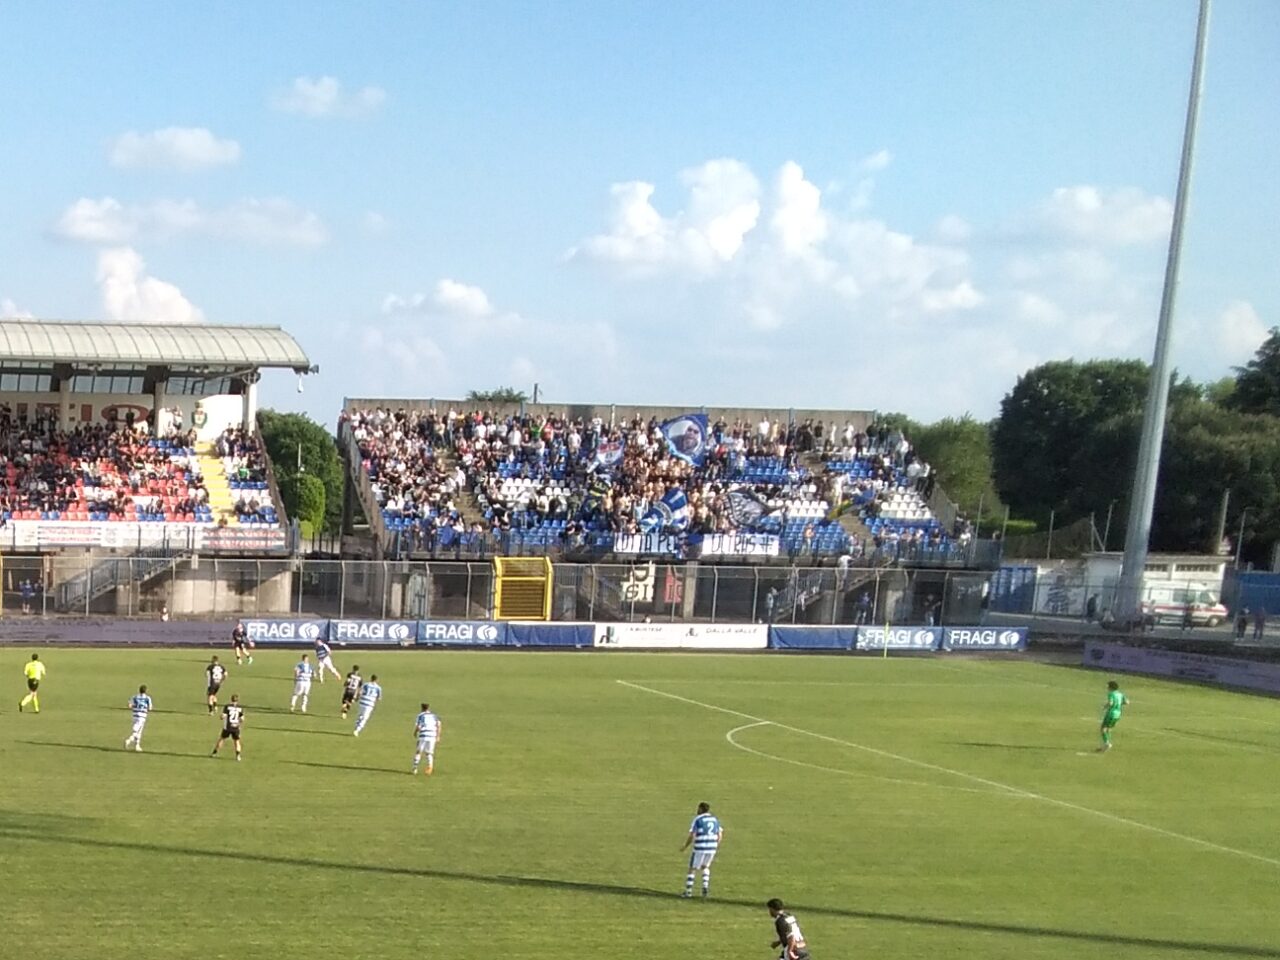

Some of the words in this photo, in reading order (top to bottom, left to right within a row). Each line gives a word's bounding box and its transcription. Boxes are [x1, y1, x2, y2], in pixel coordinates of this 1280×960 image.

[246, 622, 295, 638] FRAGI
[336, 622, 384, 639] FRAGI
[425, 623, 473, 640] FRAGI
[866, 629, 911, 643] FRAGI
[950, 630, 996, 645] FRAGI
[707, 821, 715, 836] 2
